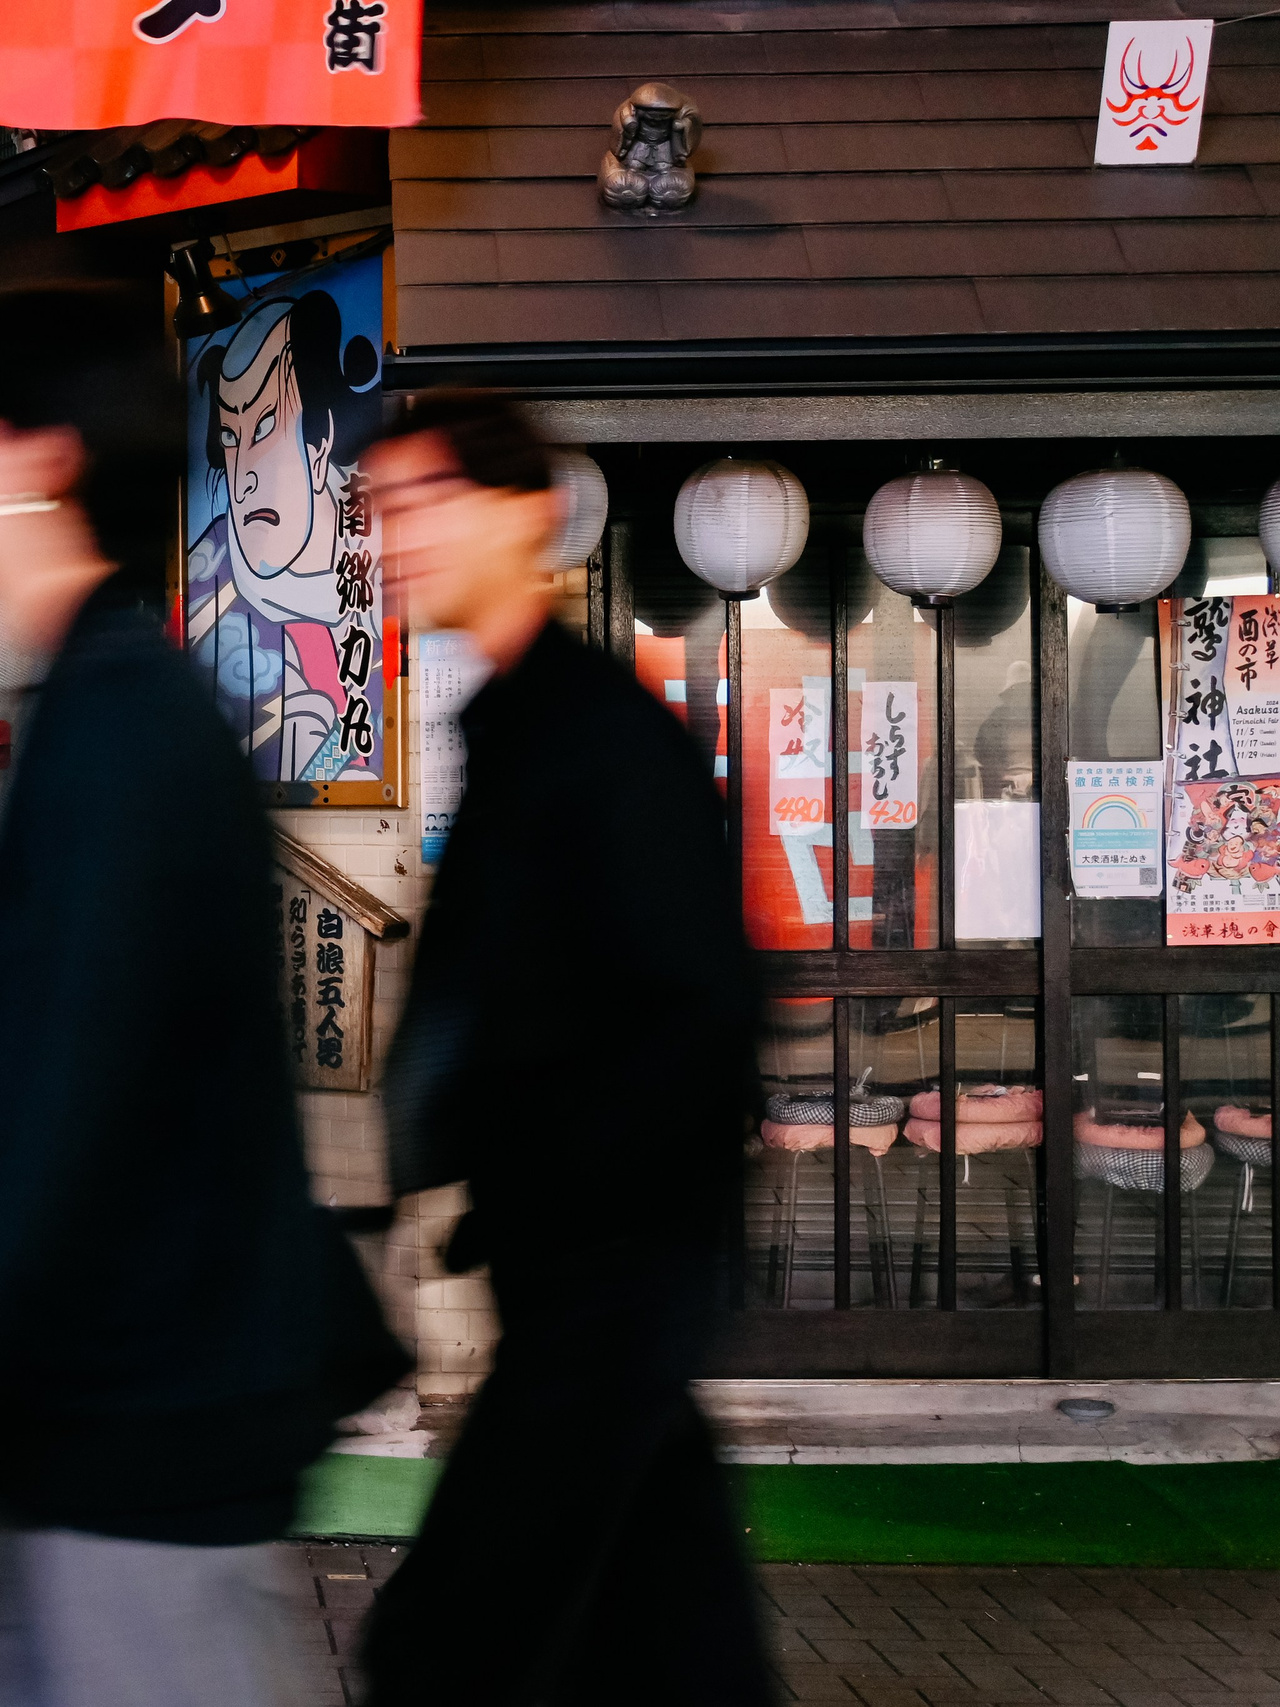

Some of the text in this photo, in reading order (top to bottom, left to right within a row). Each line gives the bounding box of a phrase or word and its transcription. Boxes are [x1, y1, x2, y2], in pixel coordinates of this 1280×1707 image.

[336, 471, 373, 755] 南郷力丸
[1235, 608, 1259, 692] 酉の市
[1236, 704, 1279, 715] Asakusa
[885, 691, 907, 781] しらす
[1236, 739, 1258, 748] 11/17
[865, 731, 890, 801] おろし
[1074, 776, 1155, 788] 徹底点検済
[773, 796, 824, 825] 480
[869, 800, 917, 825] 420
[1081, 854, 1147, 864] 大衆酒場たぬき
[316, 907, 346, 1069] 白浪五人男
